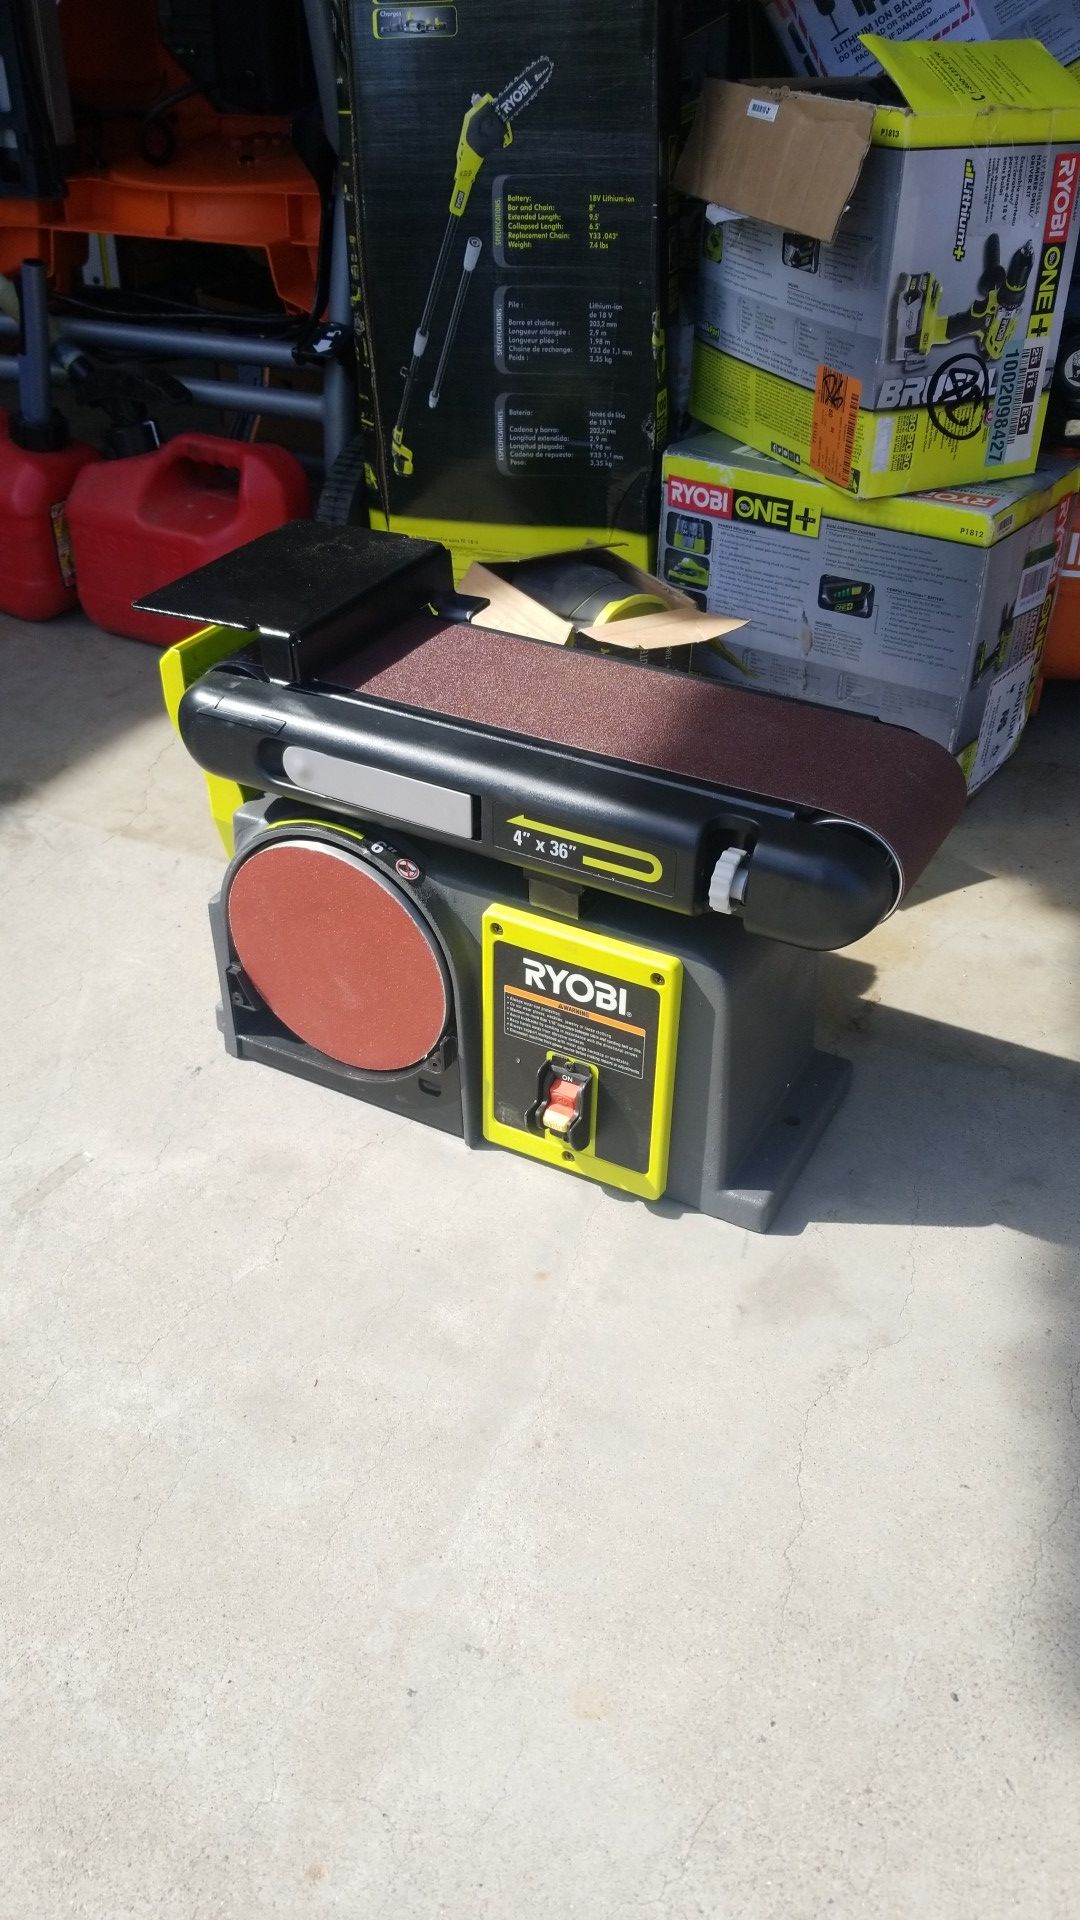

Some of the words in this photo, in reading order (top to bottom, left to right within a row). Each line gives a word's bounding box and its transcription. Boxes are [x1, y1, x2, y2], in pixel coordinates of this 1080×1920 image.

[874, 10, 893, 27] ION
[896, 7, 933, 35] DAMAGED
[839, 52, 850, 63] DO
[887, 21, 898, 30] OR
[500, 79, 532, 114] RYOBI
[880, 127, 900, 138] P1813
[1028, 155, 1036, 183] DRIVER
[1033, 155, 1042, 190] HAMMER
[508, 195, 531, 203] Battery:
[1049, 158, 1076, 237] RYOBI
[538, 214, 561, 222] Length:
[508, 223, 539, 231] Collapsed
[540, 223, 563, 231] Length:
[508, 232, 548, 240] Replacement
[508, 241, 532, 249] Weight:
[589, 302, 623, 310] Lithium-ion
[1027, 372, 1036, 388] 16
[989, 349, 1020, 461] 1002098427
[670, 480, 729, 513] RYOBI
[959, 527, 984, 538] P1812
[513, 829, 531, 846] 4"
[535, 839, 546, 853] x
[549, 840, 577, 859] 36"
[522, 957, 627, 1016] RYOBI
[563, 1003, 589, 1018] WARNING
[562, 1074, 573, 1083] ON
